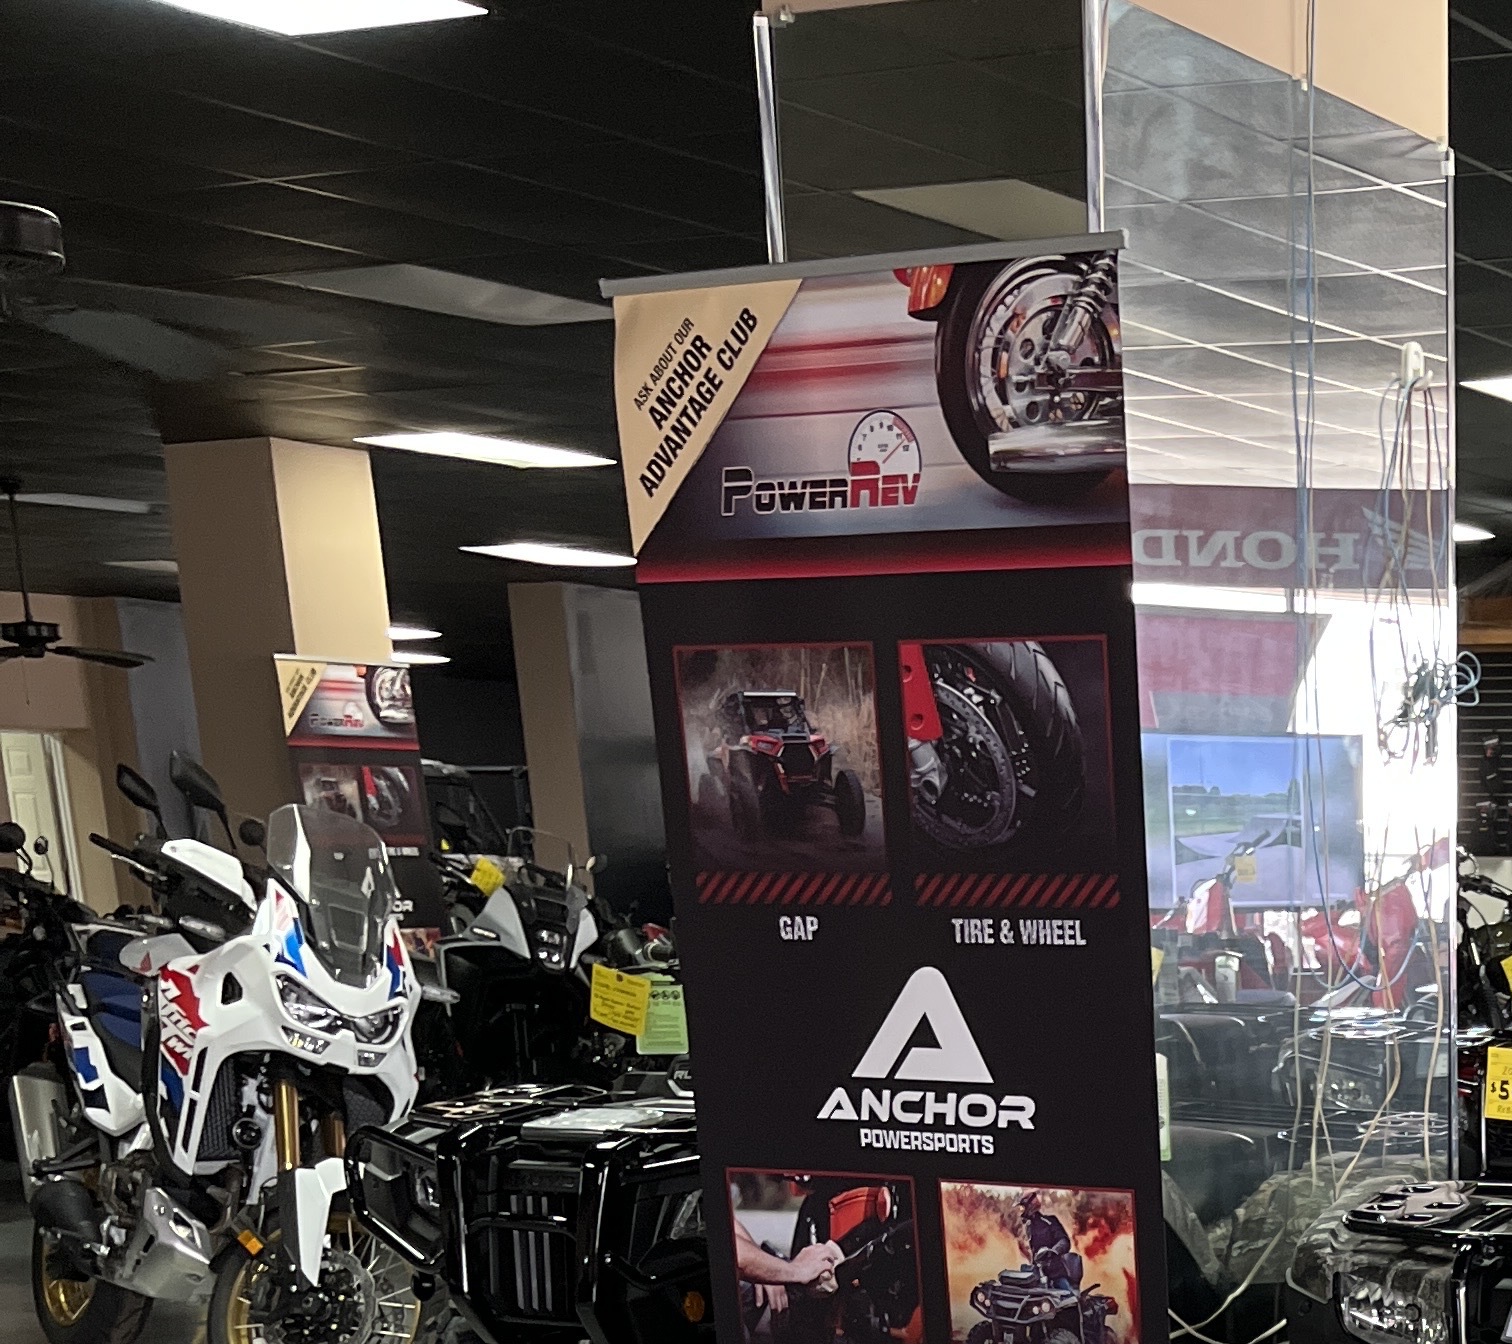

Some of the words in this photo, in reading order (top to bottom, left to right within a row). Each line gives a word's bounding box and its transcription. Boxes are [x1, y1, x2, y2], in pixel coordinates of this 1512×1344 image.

[633, 382, 653, 411] ASK
[650, 341, 677, 386] ABOUT
[674, 317, 695, 346] OUR
[648, 334, 713, 431] ANCHOR
[639, 367, 724, 498] ADVANTAGE
[716, 307, 758, 371] CLUB
[779, 915, 819, 942] GAP
[951, 918, 995, 945] TIRE
[1000, 919, 1015, 945] &
[1019, 919, 1087, 947] WHEEL
[816, 1086, 1036, 1131] ANCHOR
[859, 1127, 995, 1155] POWERSPORTS
